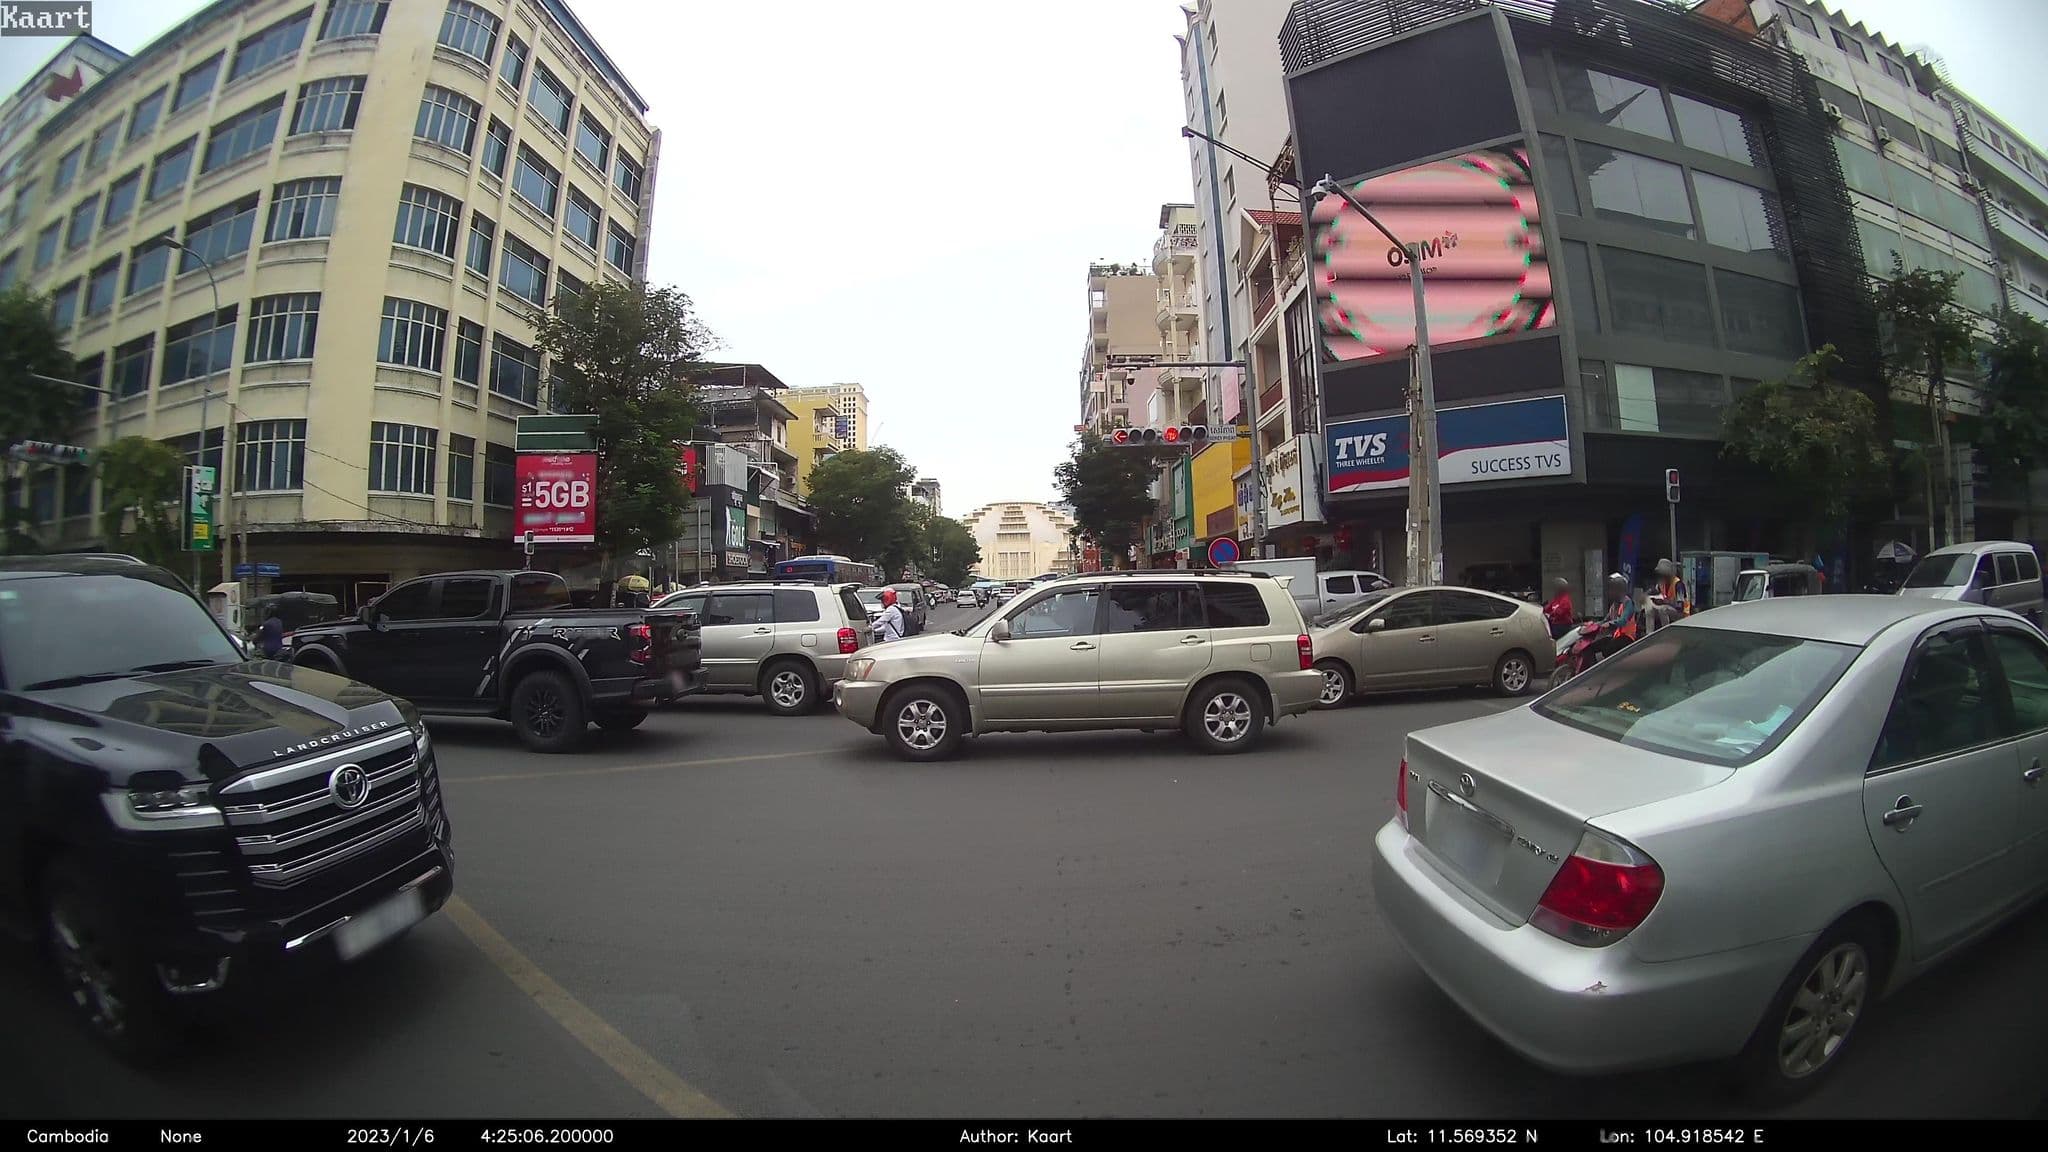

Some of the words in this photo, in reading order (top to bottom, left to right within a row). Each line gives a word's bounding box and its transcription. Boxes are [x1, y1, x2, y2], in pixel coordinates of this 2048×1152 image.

[1334, 432, 1388, 460] TVS
[1336, 460, 1356, 468] THREE
[1471, 456, 1531, 474] SUCCESS
[1535, 454, 1562, 469] TVS
[521, 481, 532, 493] $1
[535, 480, 590, 508] 5GB
